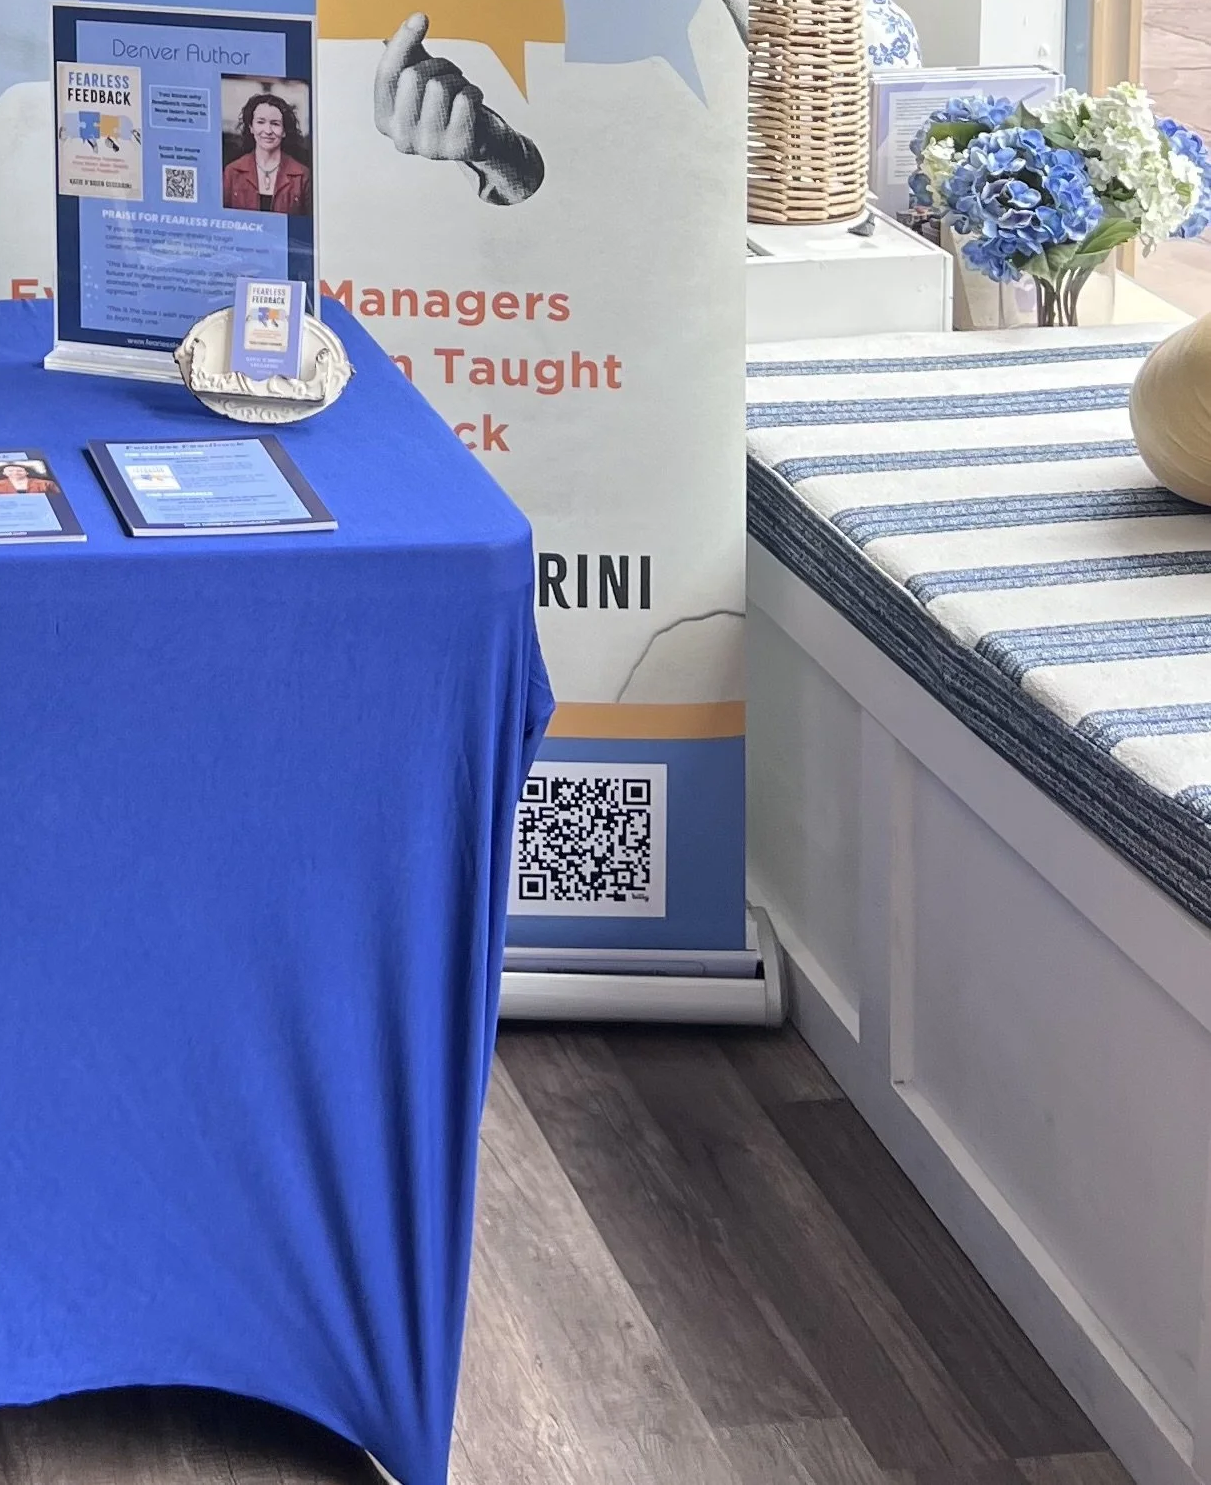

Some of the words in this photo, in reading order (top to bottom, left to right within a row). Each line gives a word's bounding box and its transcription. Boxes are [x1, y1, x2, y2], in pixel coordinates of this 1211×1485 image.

[112, 38, 180, 61] Denver
[186, 43, 251, 65] Author
[68, 72, 130, 89] FEARLESS
[67, 88, 131, 106] FEEDBACK
[102, 209, 137, 221] PRAISE
[138, 212, 158, 222] FOR
[160, 213, 208, 228] FEARLESS
[210, 218, 265, 232] FEEDBACK
[319, 279, 571, 327] Managers
[433, 347, 623, 396] Taught
[538, 552, 651, 610] RINI
